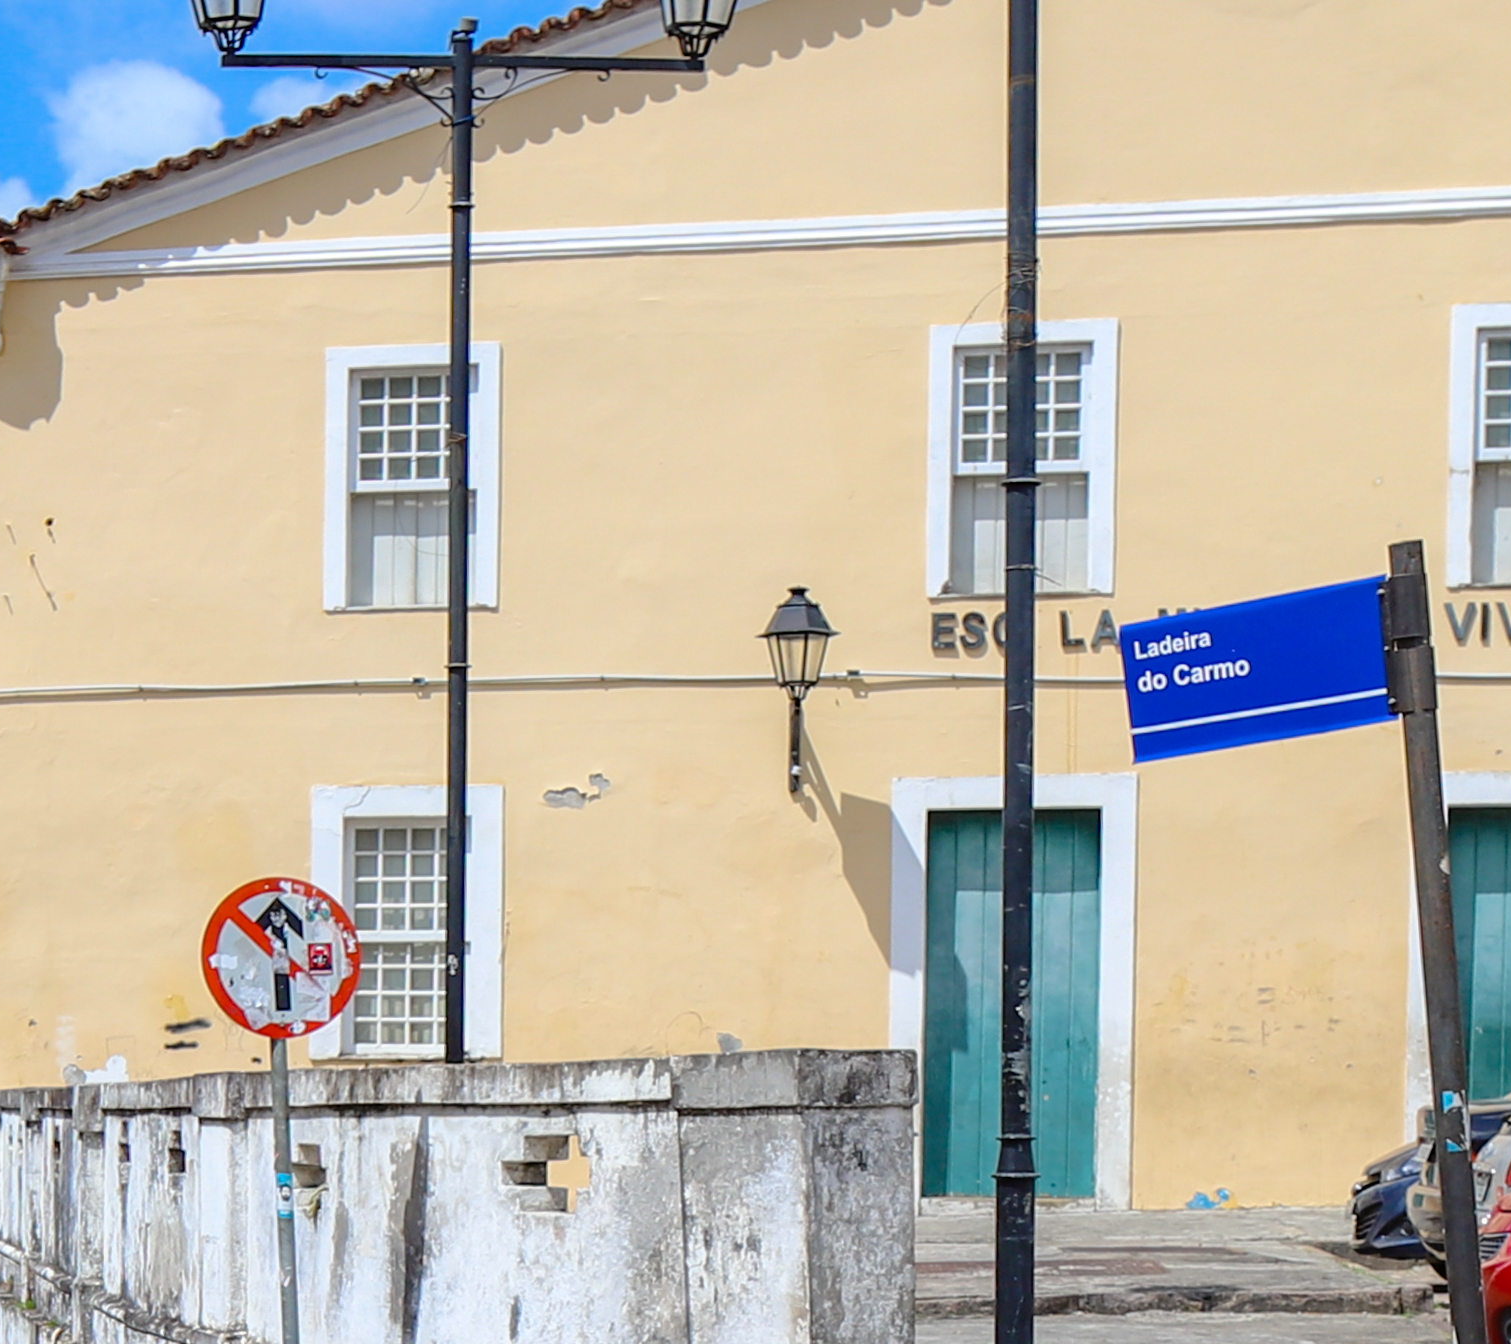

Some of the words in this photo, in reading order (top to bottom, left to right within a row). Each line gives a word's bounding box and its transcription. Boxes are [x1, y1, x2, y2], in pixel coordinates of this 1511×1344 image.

[1133, 630, 1212, 660] Ladeira
[1137, 669, 1168, 693] do
[1172, 657, 1251, 688] Carmo
